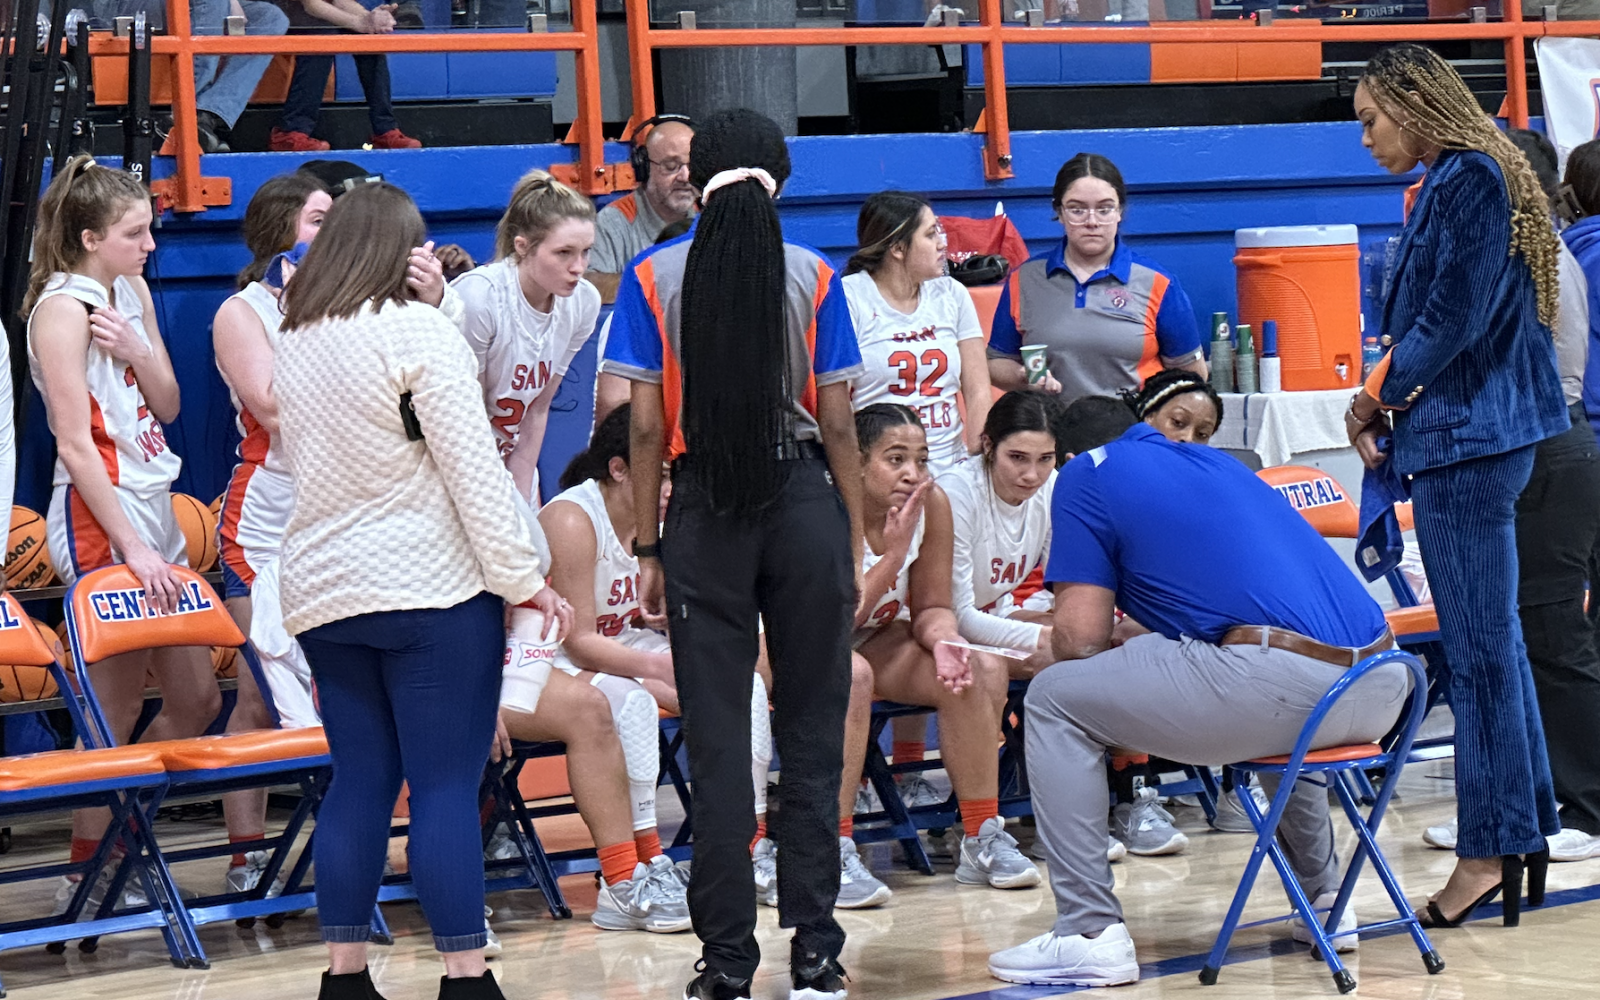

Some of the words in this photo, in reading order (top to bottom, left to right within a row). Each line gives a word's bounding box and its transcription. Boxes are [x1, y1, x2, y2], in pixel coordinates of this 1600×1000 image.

[511, 360, 553, 391] SAN
[887, 348, 949, 397] 32
[1275, 479, 1343, 509] NTRAL
[91, 582, 212, 620] CENTAL
